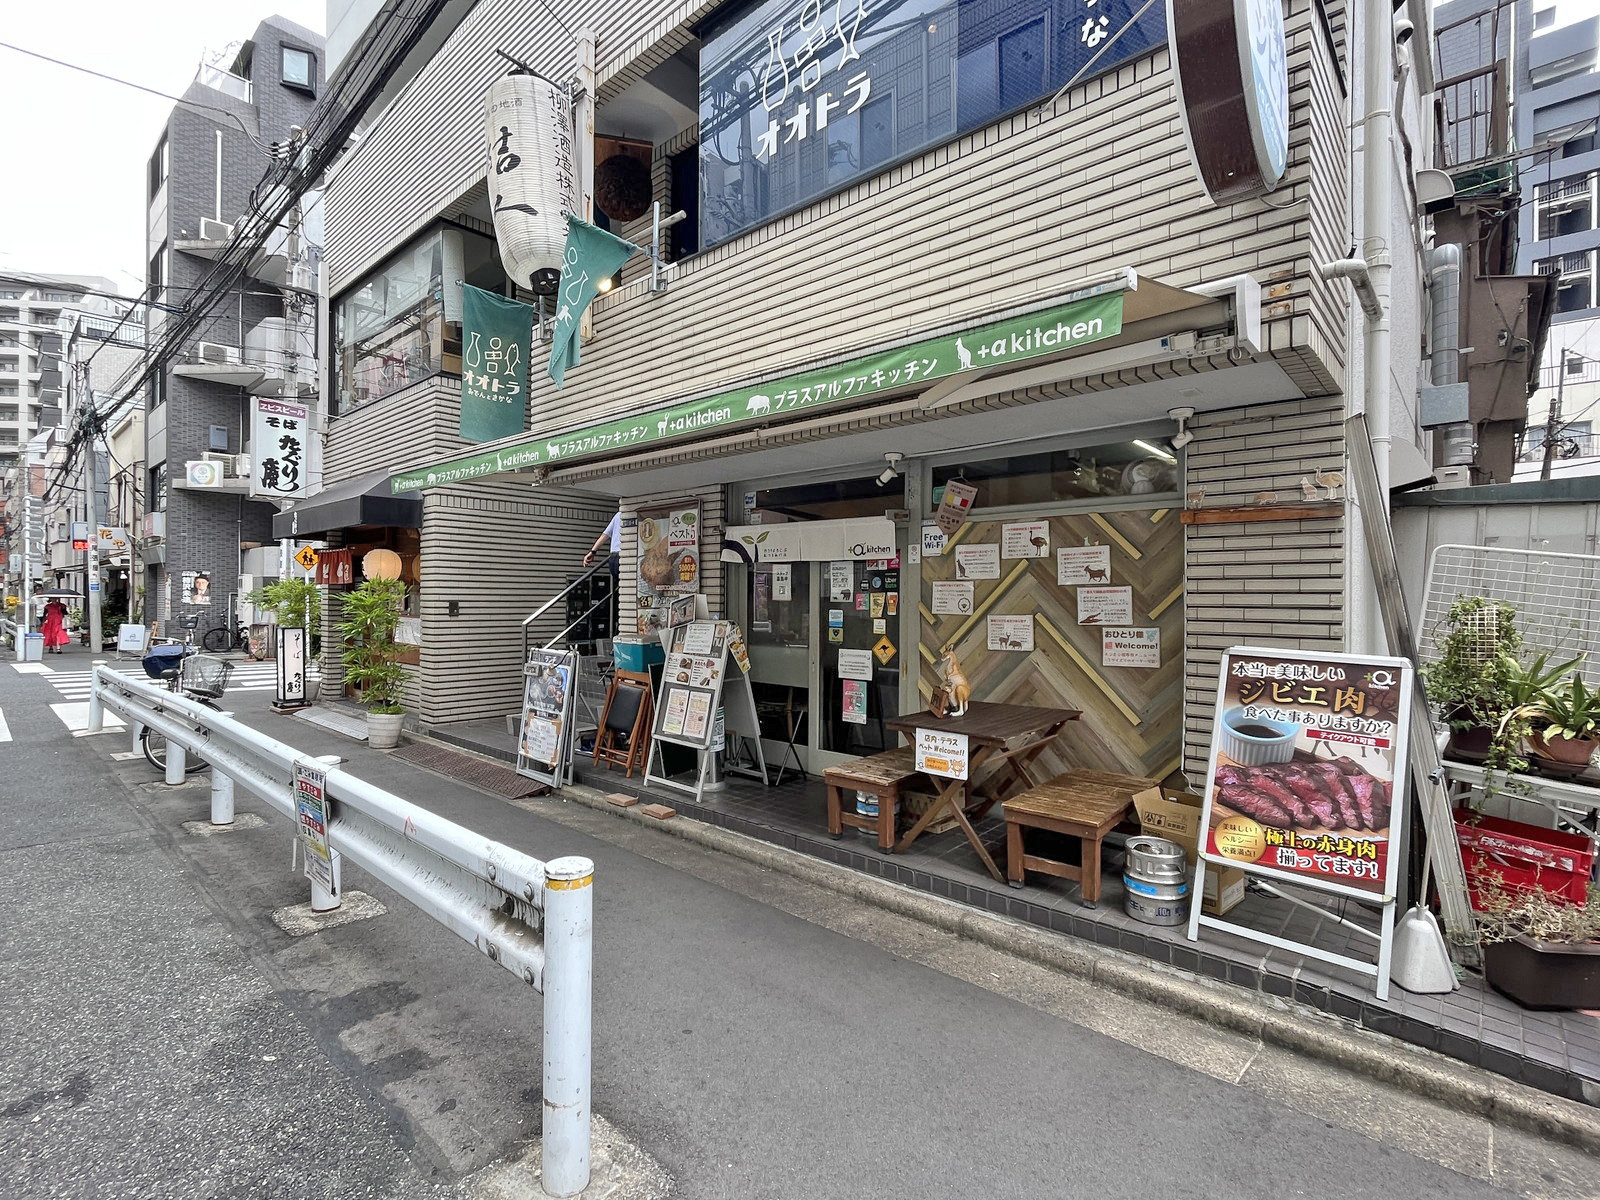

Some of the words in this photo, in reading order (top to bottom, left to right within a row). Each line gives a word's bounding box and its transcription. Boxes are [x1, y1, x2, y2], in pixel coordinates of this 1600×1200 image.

[756, 71, 872, 159] オオトラ
[463, 370, 521, 395] オオトラ
[774, 357, 939, 411] プラスアルファキッチン
[265, 416, 299, 430] そば
[561, 426, 649, 456] プラスアルファキッチン
[279, 435, 302, 492] たぐり
[436, 462, 492, 483] プラスアルファキッチン
[924, 533, 944, 541] Free
[924, 541, 944, 549] Wi-Fi
[1114, 642, 1159, 650] Welcome!
[1232, 661, 1346, 681] 本当に美味しい
[1240, 680, 1367, 715] ジビエ肉
[1243, 706, 1392, 735] 食べた事ありますか?
[918, 743, 933, 751] ペット
[1319, 731, 1377, 747] テイクアウト可能
[1222, 822, 1259, 834] 美味しい!
[1222, 835, 1259, 846] ヘルシー!
[1264, 827, 1377, 860] 極上の赤身肉
[1221, 846, 1257, 859] 栄養満点!
[1276, 849, 1379, 878] 揃ってます!
